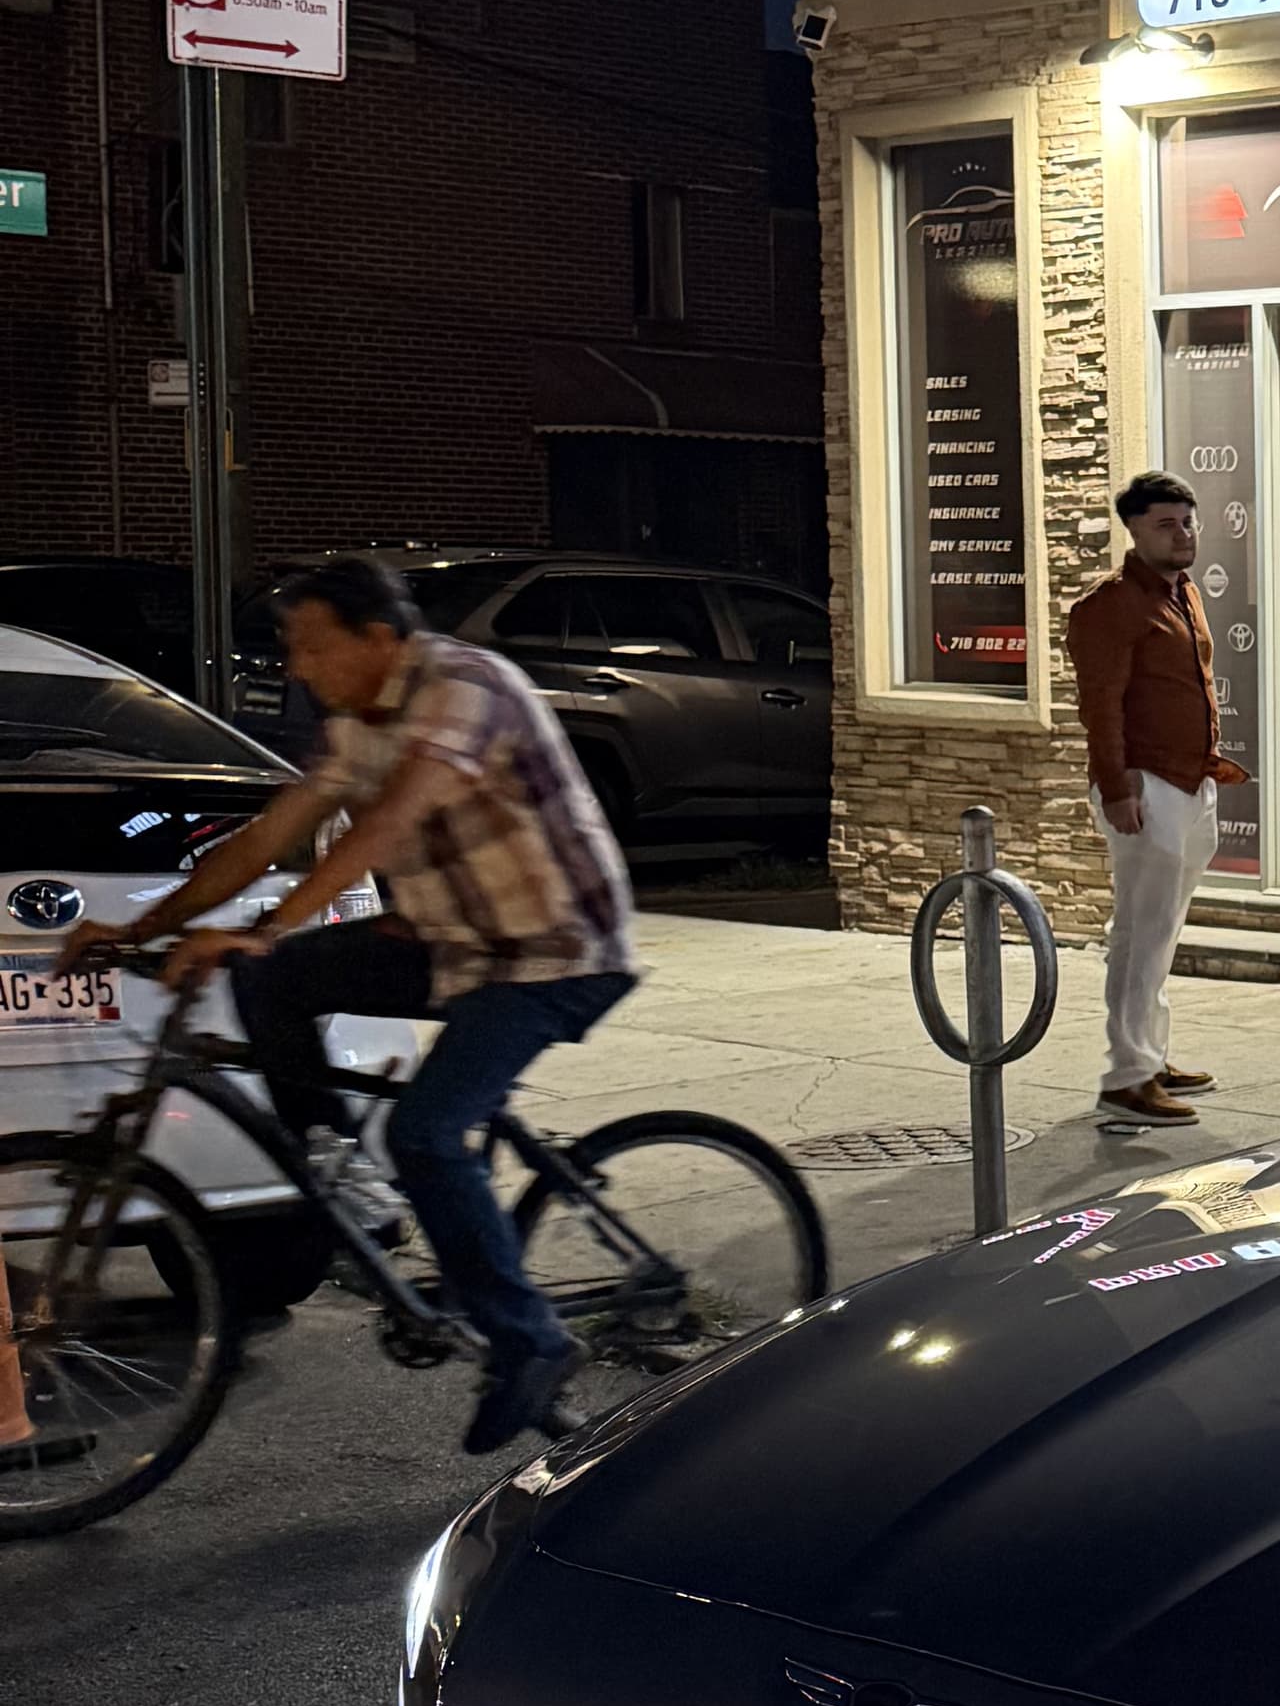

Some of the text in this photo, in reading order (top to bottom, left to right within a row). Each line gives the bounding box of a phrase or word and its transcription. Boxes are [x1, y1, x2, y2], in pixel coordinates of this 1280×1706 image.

[920, 223, 963, 244] PRO
[926, 376, 968, 389] SALES
[926, 408, 981, 422] LEASING
[927, 441, 996, 455] FINANCING
[928, 474, 1000, 487] USED CARS
[928, 507, 1000, 520] INSURANCE
[929, 540, 1012, 552] DMV SERVICE
[930, 572, 971, 585] LEASE
[950, 636, 973, 650] 718
[976, 637, 1003, 651] 902
